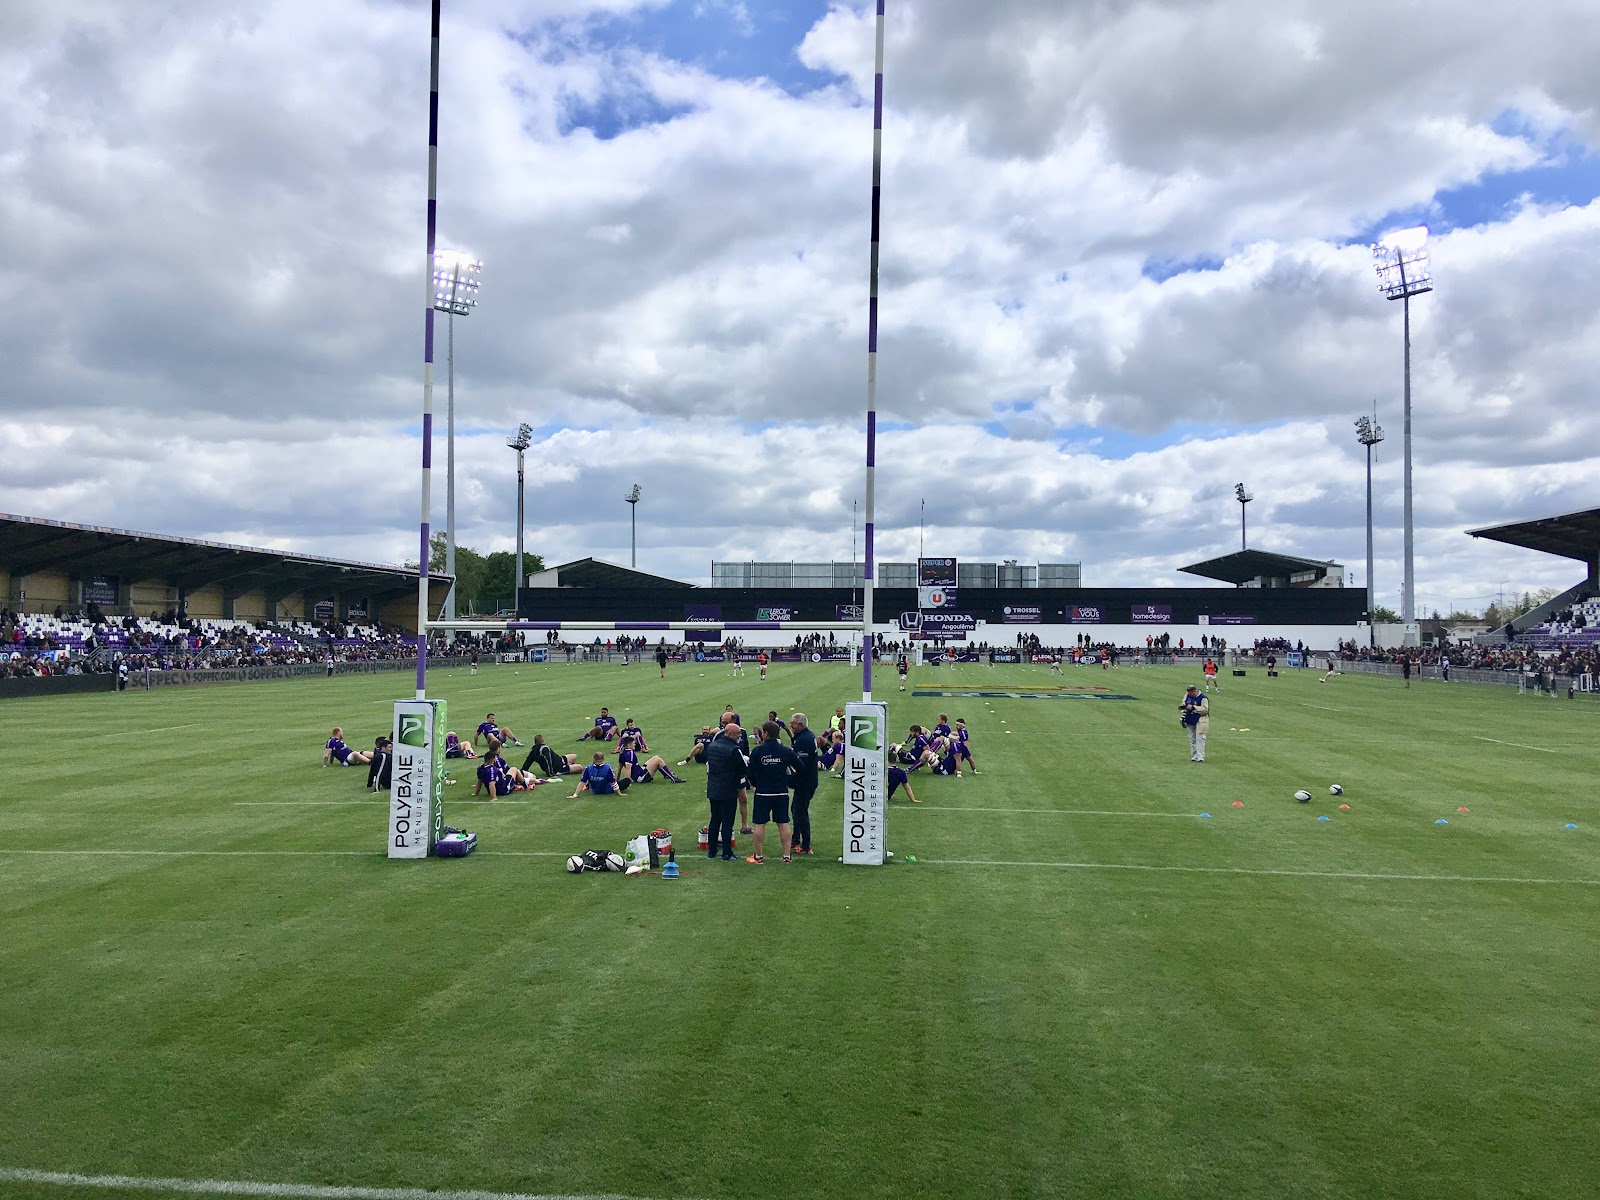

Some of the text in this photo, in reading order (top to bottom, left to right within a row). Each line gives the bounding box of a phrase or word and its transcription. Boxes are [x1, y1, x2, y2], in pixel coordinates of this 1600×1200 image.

[932, 594, 942, 603] U
[192, 671, 236, 682] SOPPEC.COM
[248, 668, 284, 680] SOPPEC
[335, 662, 365, 674] SOPPEC
[395, 712, 445, 848] POLYBAIE MENUISERIES POLYBAIE.COM
[850, 758, 866, 852] POLYBAIE
